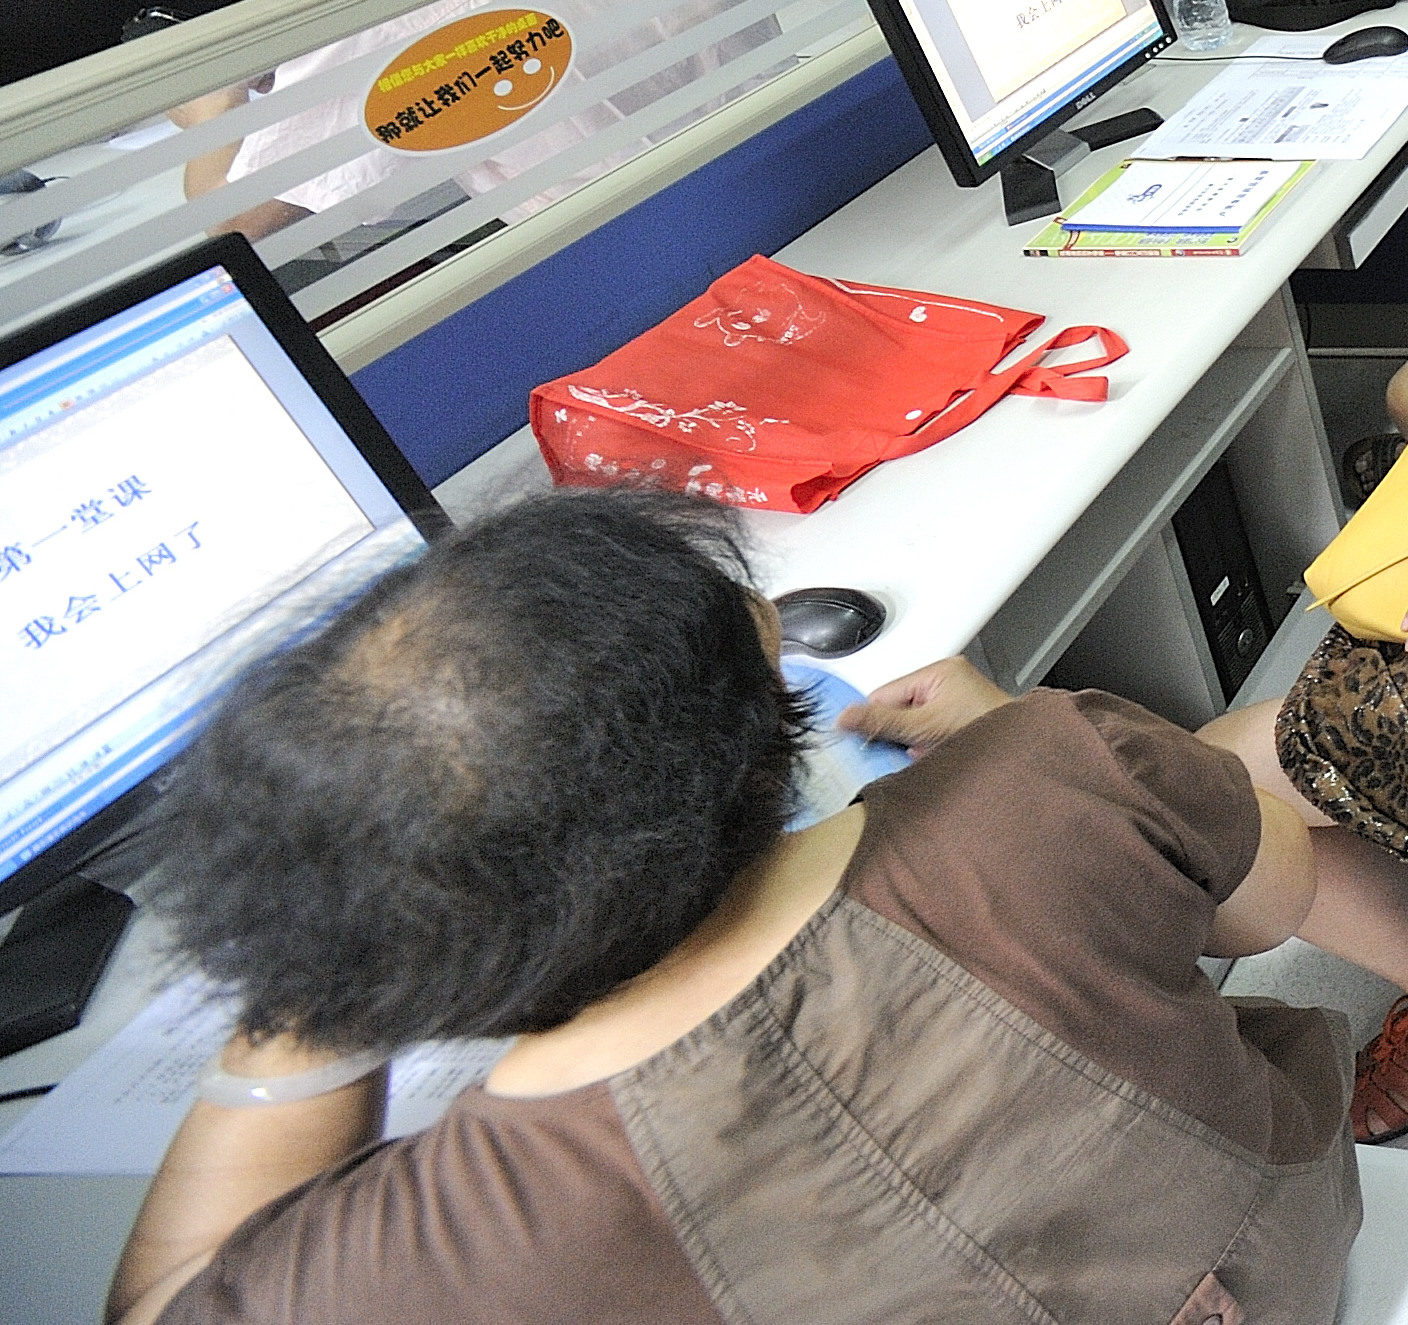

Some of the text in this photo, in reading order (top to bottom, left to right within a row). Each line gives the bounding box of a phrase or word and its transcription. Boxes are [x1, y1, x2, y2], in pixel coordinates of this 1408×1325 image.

[375, 18, 566, 144] 那就让我们一起努力吧
[1075, 91, 1097, 110] DELL
[16, 520, 203, 650] 我会上网了
